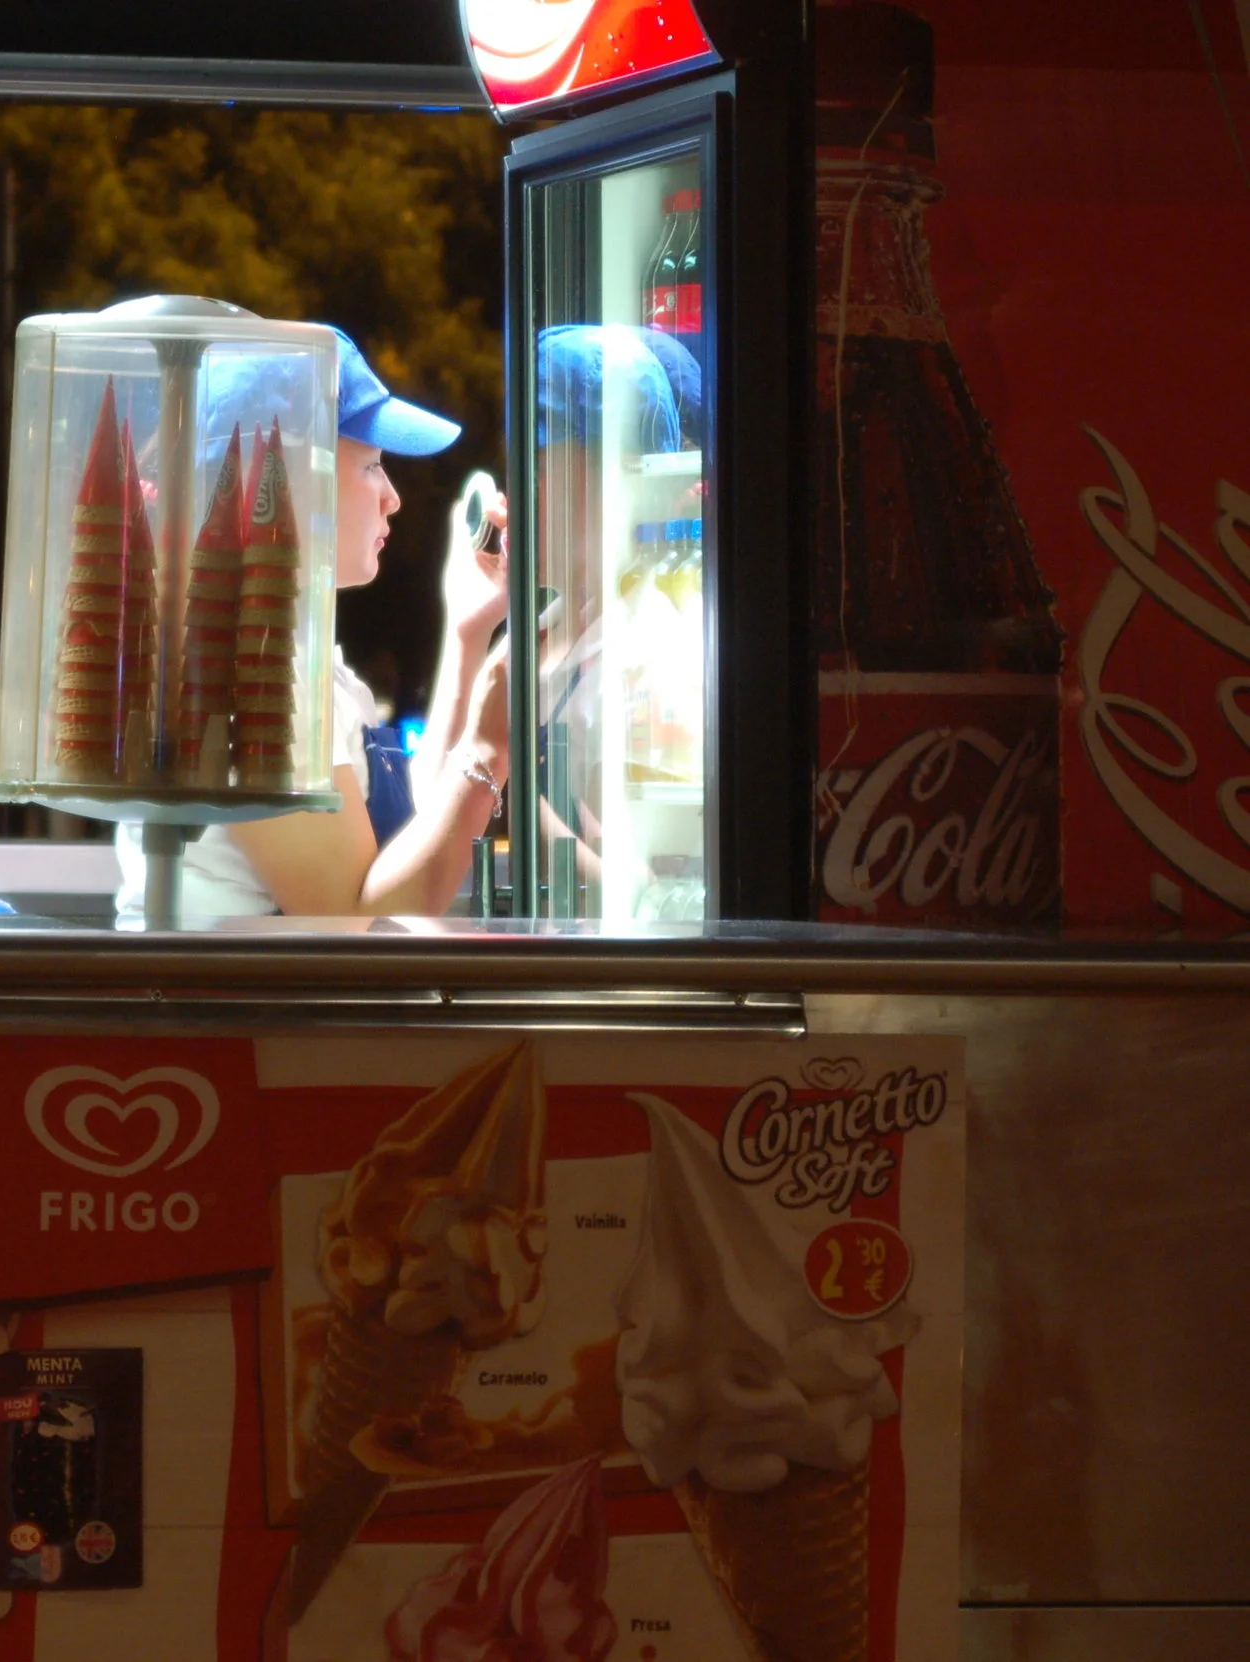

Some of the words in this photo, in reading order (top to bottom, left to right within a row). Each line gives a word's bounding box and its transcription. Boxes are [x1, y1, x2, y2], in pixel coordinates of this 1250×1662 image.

[720, 1066, 947, 1185] Cornetto
[774, 1142, 897, 1213] Soft
[39, 1191, 200, 1232] FRIGO
[574, 1214, 627, 1230] Vainilla
[820, 1237, 844, 1300] 2
[26, 1356, 83, 1372] MENTA
[36, 1374, 76, 1385] MINT
[478, 1371, 548, 1386] Caramelo
[630, 1618, 671, 1632] Fresa
